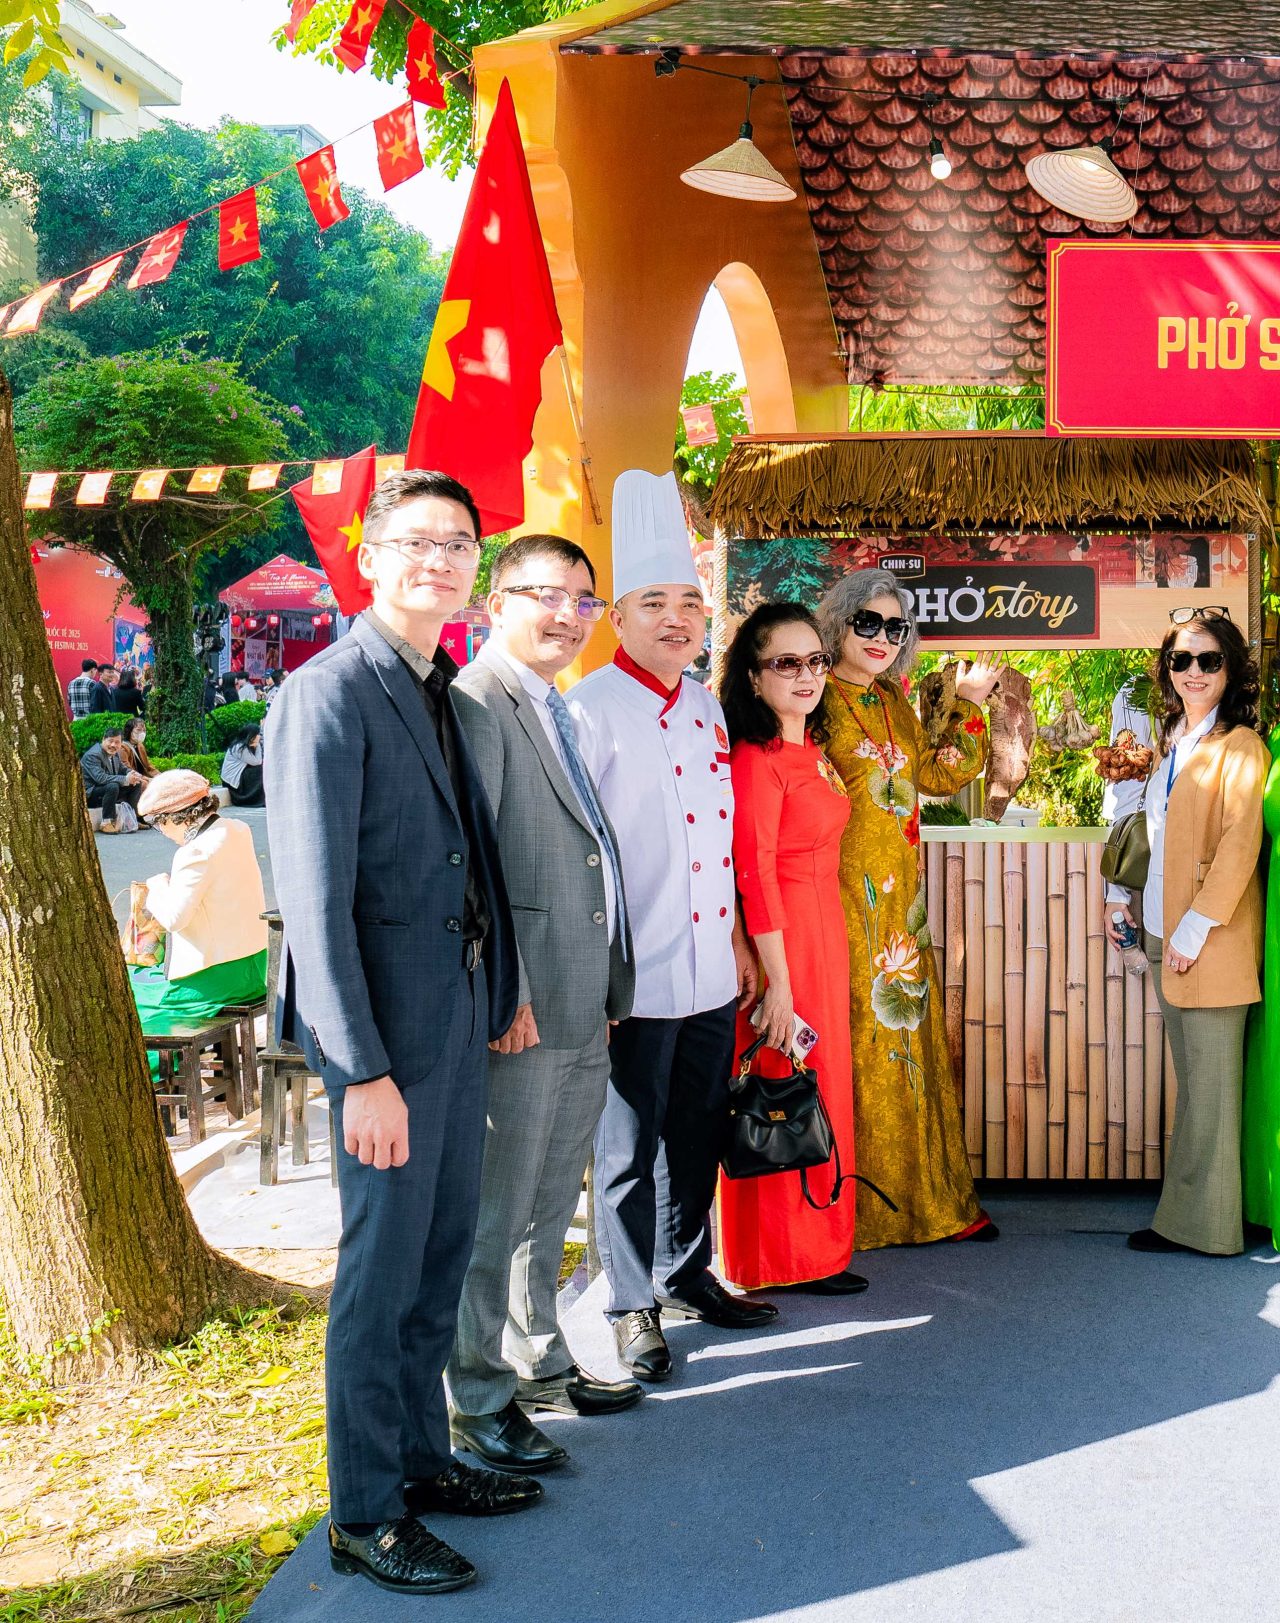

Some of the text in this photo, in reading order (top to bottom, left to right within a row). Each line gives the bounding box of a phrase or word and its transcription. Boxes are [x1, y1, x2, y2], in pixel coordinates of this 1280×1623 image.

[1157, 301, 1252, 370] PHỞ
[881, 559, 921, 569] CHIN-SU
[985, 581, 1079, 629] story
